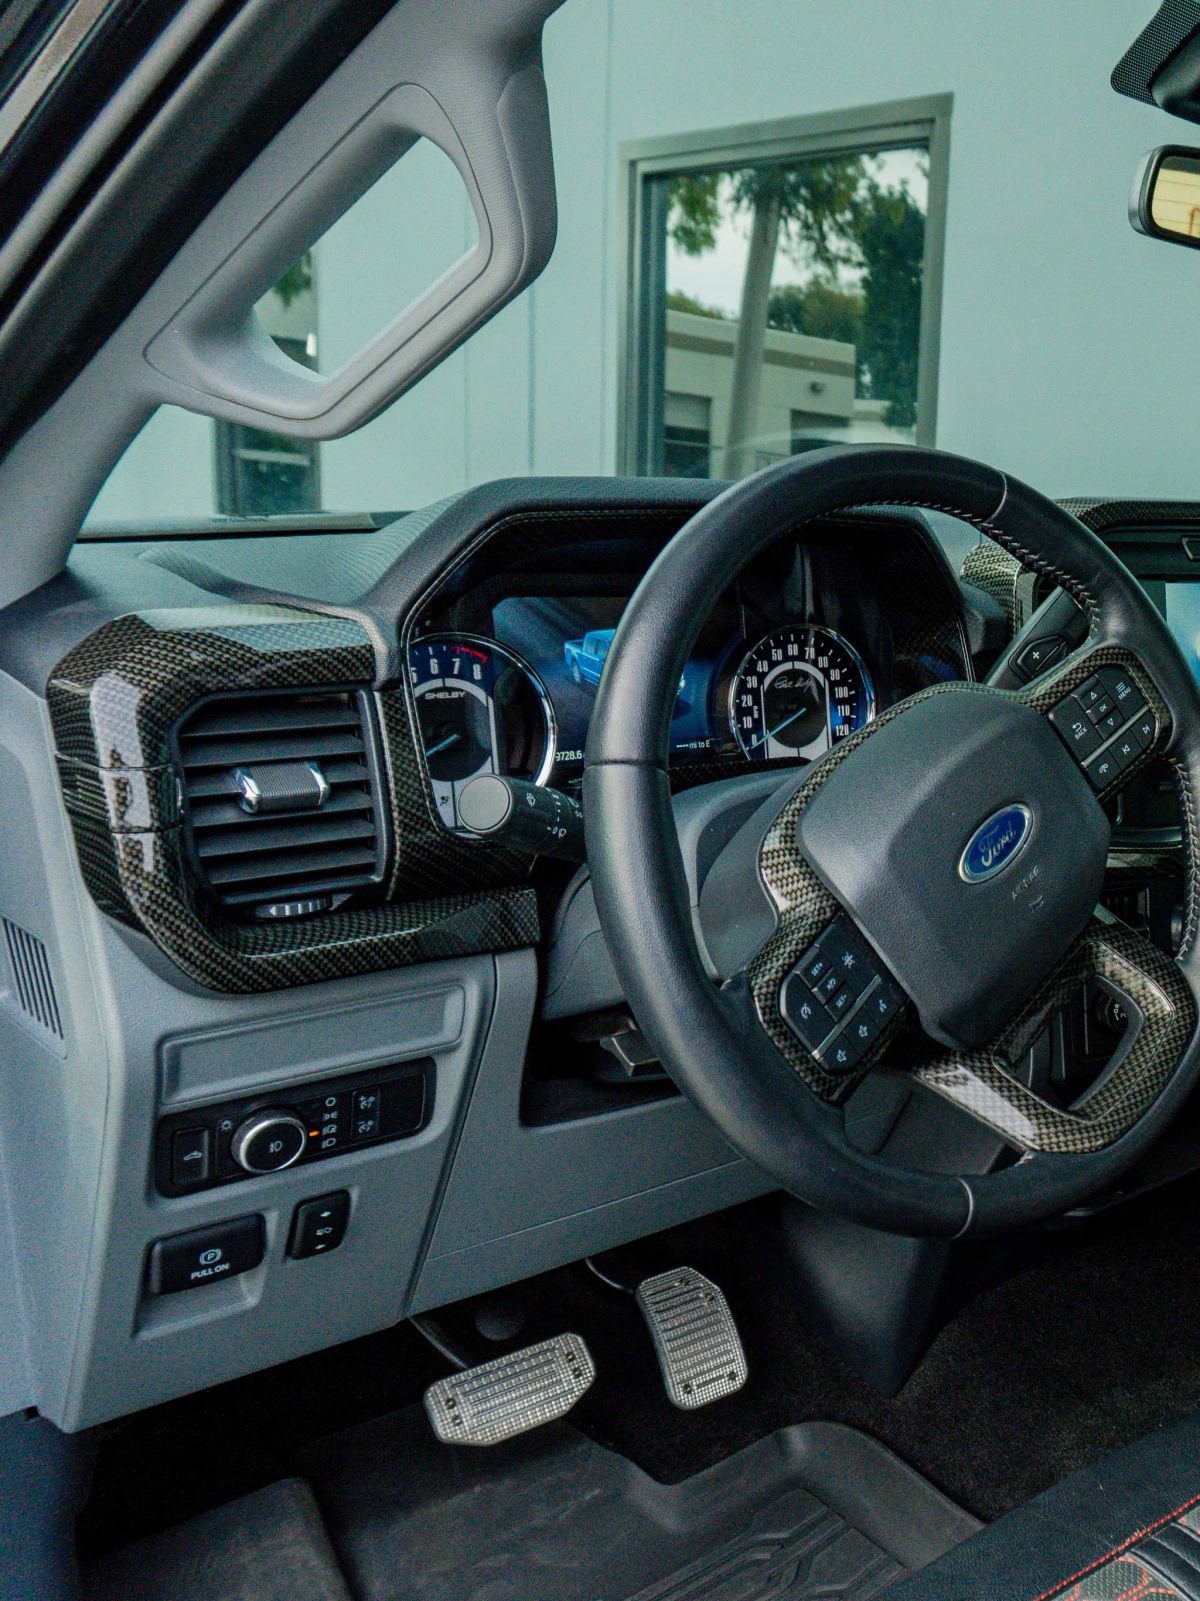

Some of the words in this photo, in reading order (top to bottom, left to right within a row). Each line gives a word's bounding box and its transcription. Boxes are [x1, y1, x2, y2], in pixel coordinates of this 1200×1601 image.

[771, 648, 783, 661] 50
[788, 643, 798, 656] 60
[805, 647, 815, 660] 70
[430, 658, 438, 675] 6
[452, 658, 460, 675] 7
[757, 660, 769, 673] 40
[818, 656, 829, 668] 80
[473, 664, 482, 680] 8
[830, 668, 841, 680] 90
[747, 676, 758, 688] 30
[425, 691, 465, 700] SHELBY
[835, 686, 848, 699] 100
[1118, 686, 1132, 700] MENU
[742, 695, 752, 707] 20
[1100, 703, 1107, 712] OK
[837, 704, 850, 717] 110
[743, 717, 752, 729] 10
[836, 724, 849, 736] 120
[1074, 726, 1088, 740] BACK
[978, 820, 1016, 867] Ford
[191, 1269, 214, 1280] PULL
[214, 1263, 230, 1273] ON
